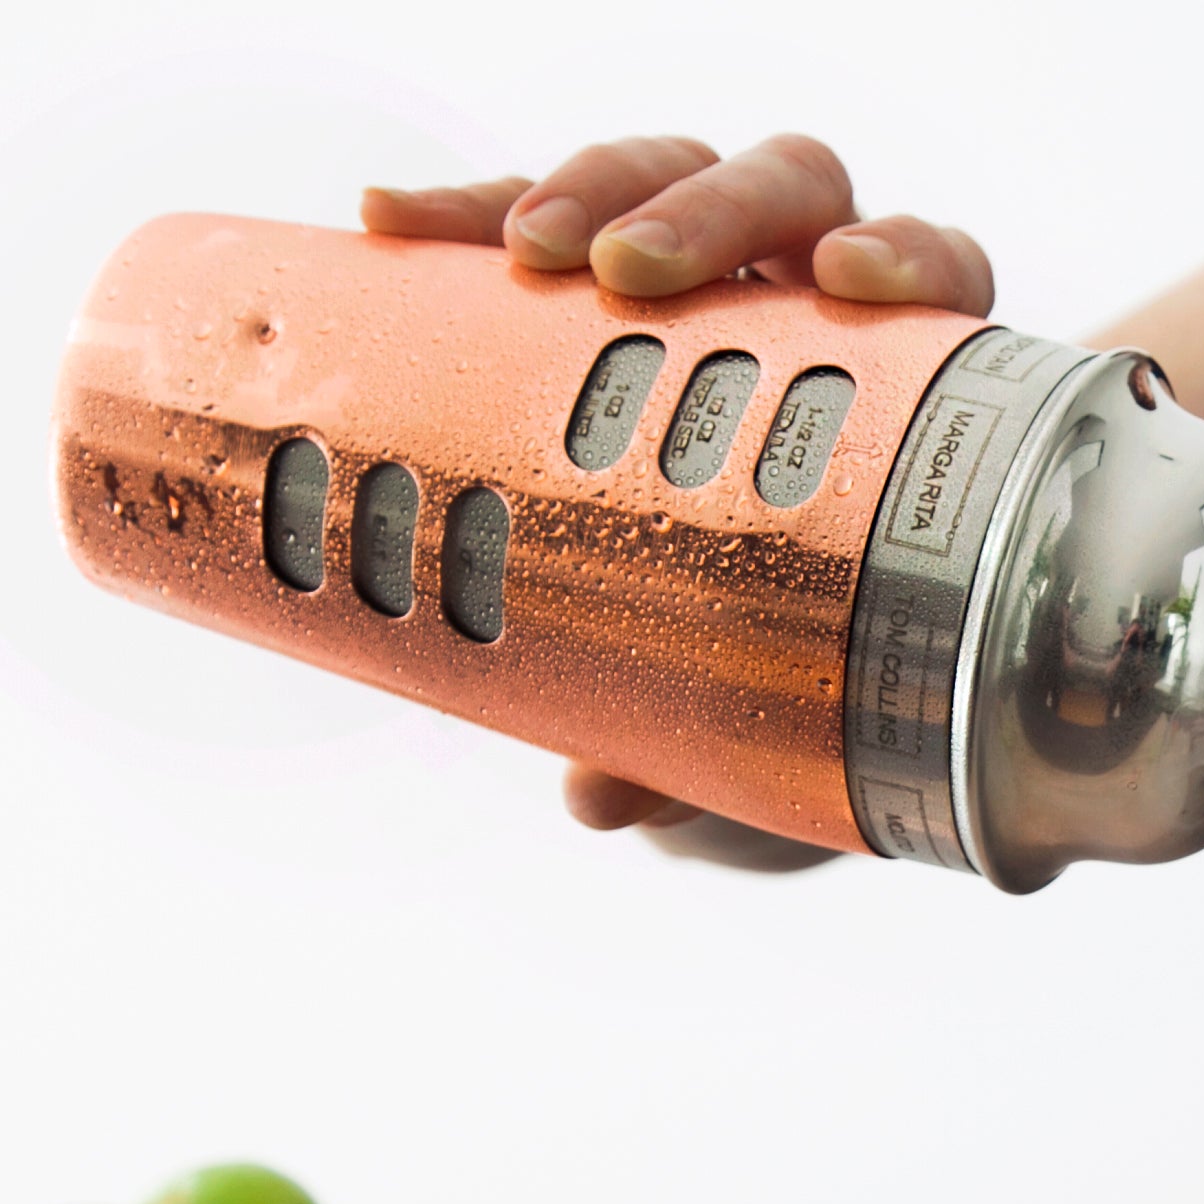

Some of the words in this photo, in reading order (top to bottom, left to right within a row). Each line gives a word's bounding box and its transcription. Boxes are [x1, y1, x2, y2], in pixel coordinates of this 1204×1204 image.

[683, 376, 717, 422] TRIPLE
[672, 425, 693, 458] SEC
[696, 420, 716, 443] OZ
[796, 407, 822, 441] 1-1/2
[787, 445, 806, 469] OZ
[910, 409, 975, 531] MARGARITA
[884, 593, 914, 648] TOM
[877, 654, 901, 749] COLLINS
